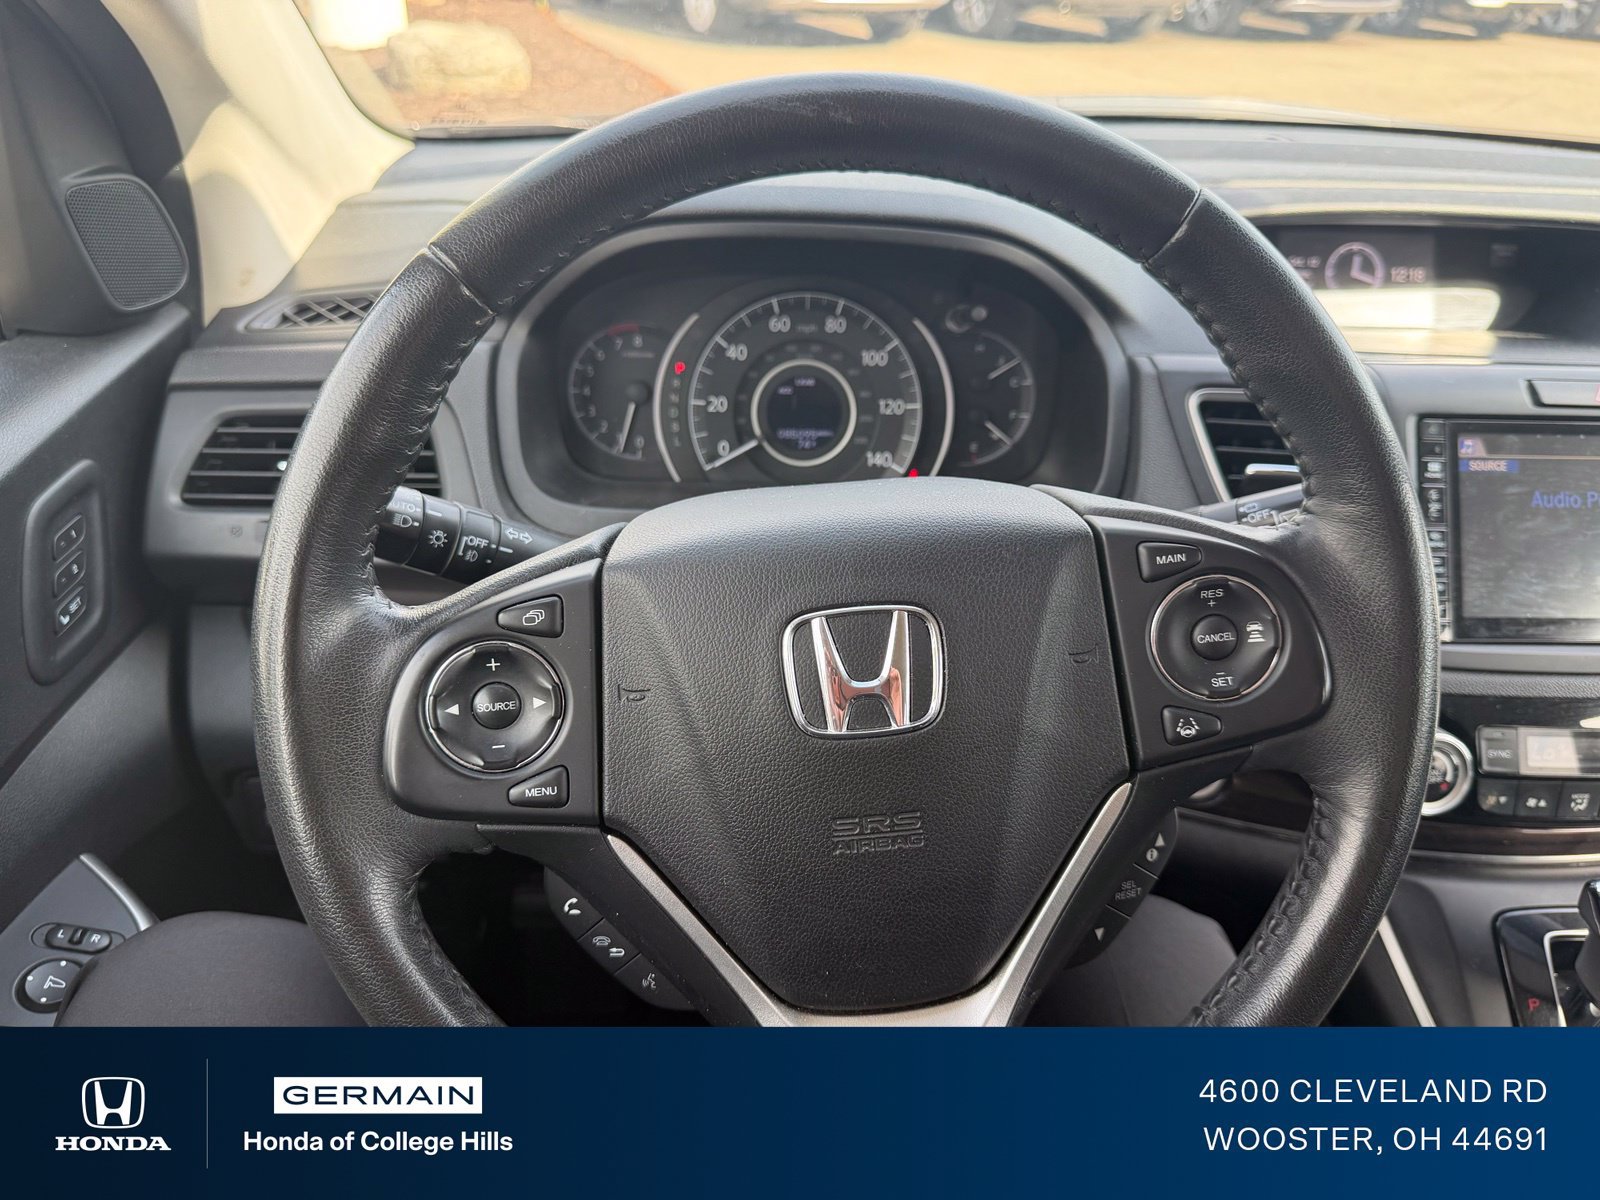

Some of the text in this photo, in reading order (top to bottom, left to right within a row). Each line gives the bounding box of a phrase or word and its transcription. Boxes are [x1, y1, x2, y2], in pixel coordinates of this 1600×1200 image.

[768, 315, 792, 333] 60
[824, 315, 848, 333] 80
[725, 344, 748, 361] 40
[861, 349, 889, 366] 100
[674, 361, 687, 375] P
[706, 395, 728, 413] 20
[879, 399, 906, 415] 120
[717, 440, 731, 457] 0
[866, 452, 894, 469] 140
[1468, 460, 1508, 472] SOURCE
[1530, 489, 1582, 509] Audio
[1247, 508, 1271, 524] OFF
[466, 535, 490, 549] OFF
[1156, 553, 1187, 566] MAIN
[1200, 588, 1224, 600] RES
[1196, 631, 1236, 644] CANCEL
[1210, 676, 1233, 688] SET
[476, 699, 517, 714] SOURCE
[524, 785, 558, 798] MENU
[831, 812, 921, 835] SRS
[832, 835, 924, 855] AIRBAG
[1121, 880, 1137, 890] SEL
[1115, 887, 1142, 901] RESET
[57, 929, 65, 939] L
[90, 933, 101, 944] R
[1528, 998, 1540, 1012] P
